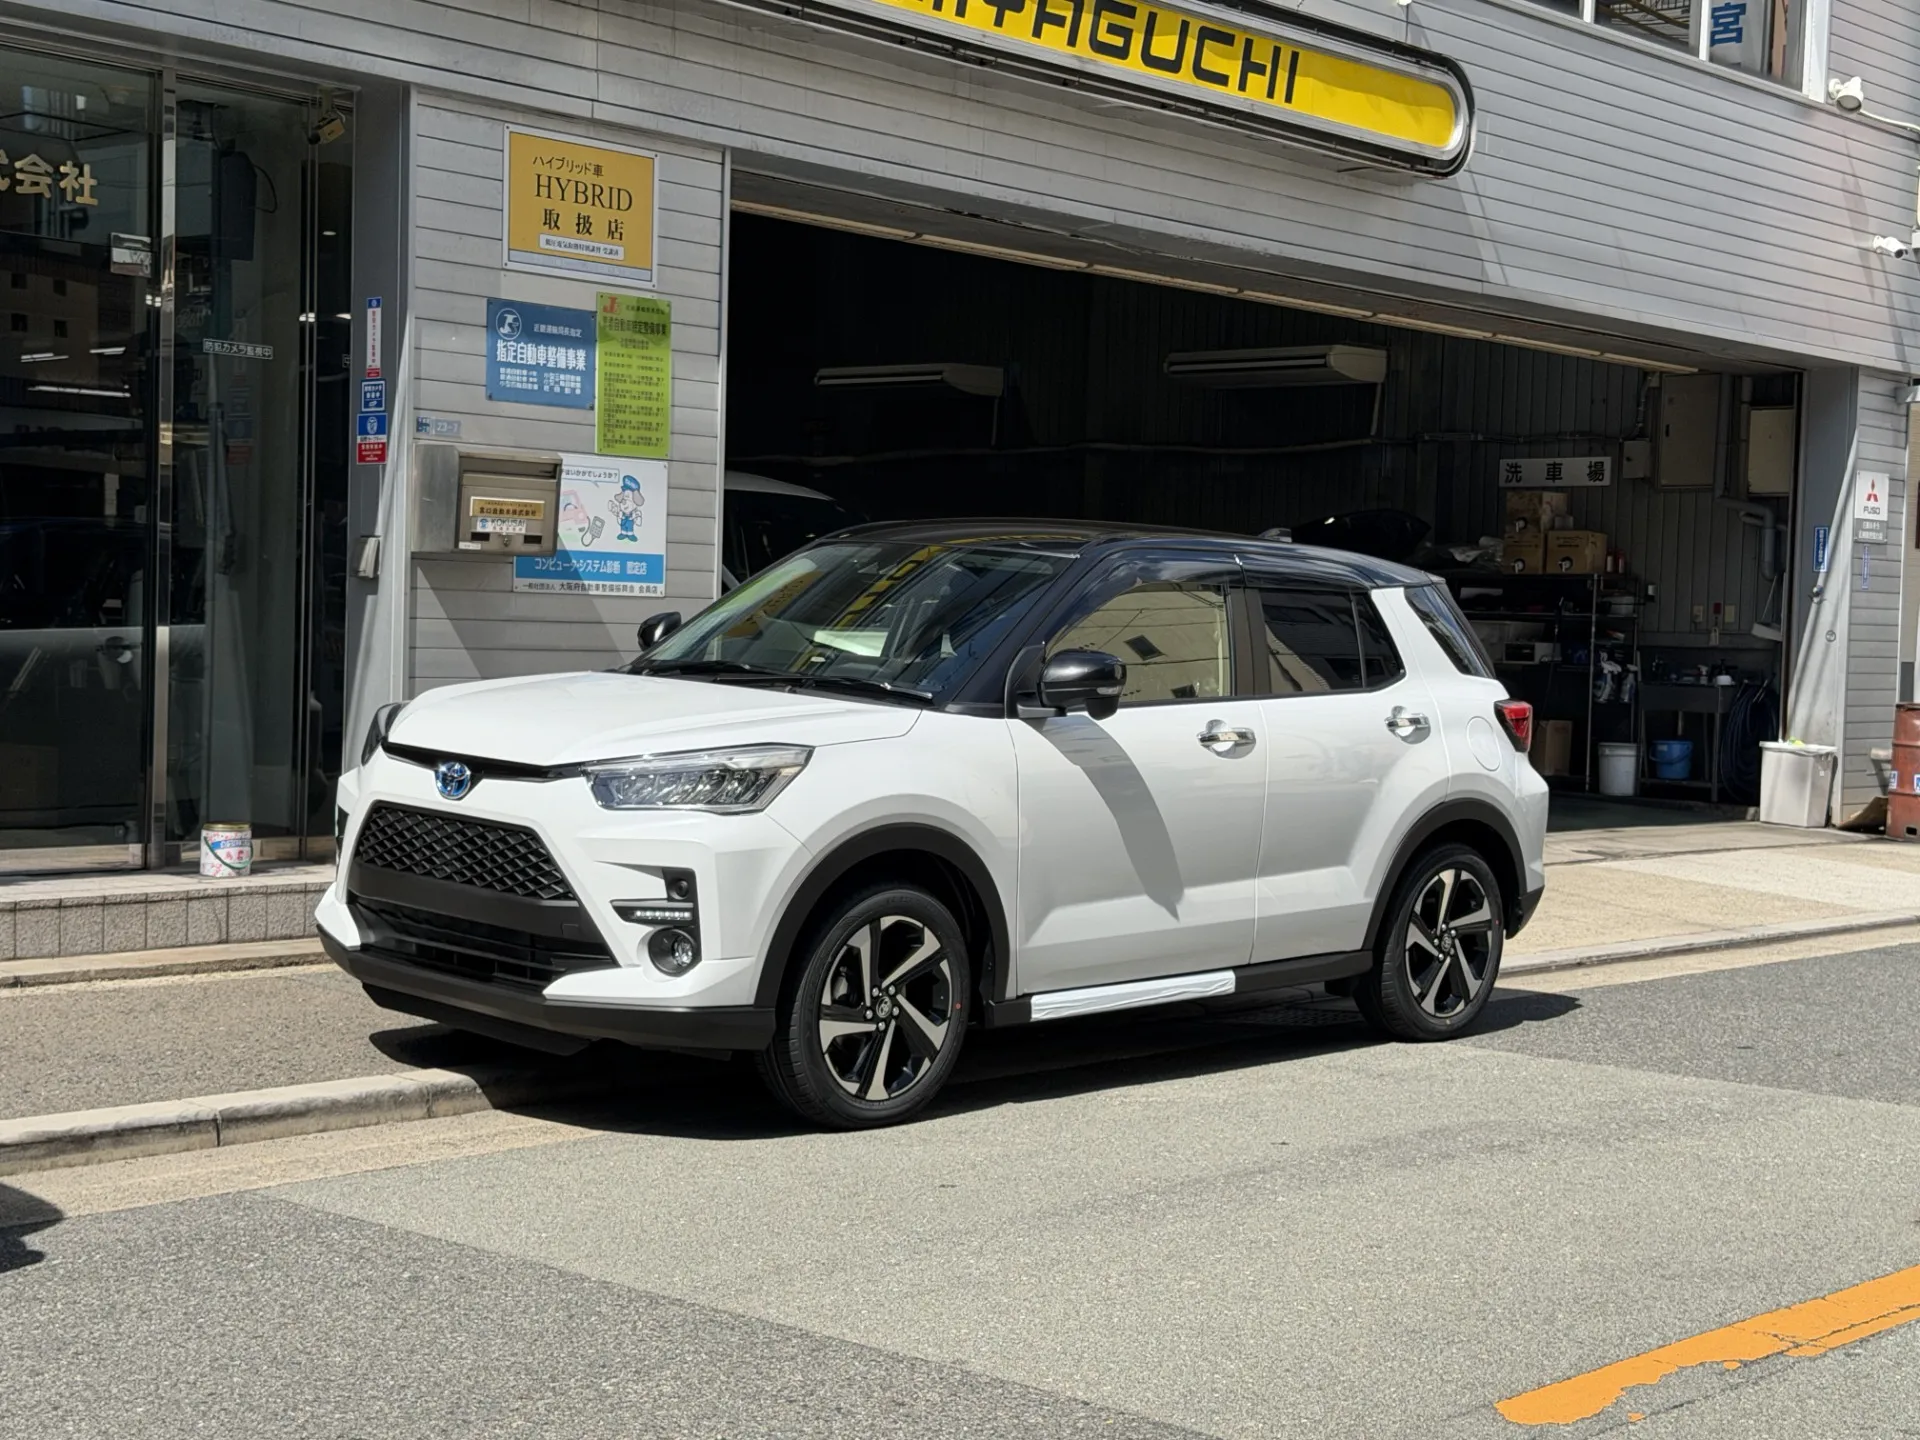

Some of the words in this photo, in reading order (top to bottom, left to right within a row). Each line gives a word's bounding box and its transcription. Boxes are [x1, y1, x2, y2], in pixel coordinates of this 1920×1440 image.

[1709, 2, 1747, 48] 宮
[915, 0, 1299, 104] YAGUCHI
[0, 149, 98, 206] 会社
[533, 156, 604, 178] ハイブリッド車
[534, 173, 632, 212] HYBRID
[543, 208, 624, 241] 取扱店
[496, 339, 586, 371] 指定自動車整備事業
[1504, 461, 1605, 483] 洗車場
[559, 582, 634, 593] 大阪府自動車整備振興会
[638, 584, 658, 594] 会員店
